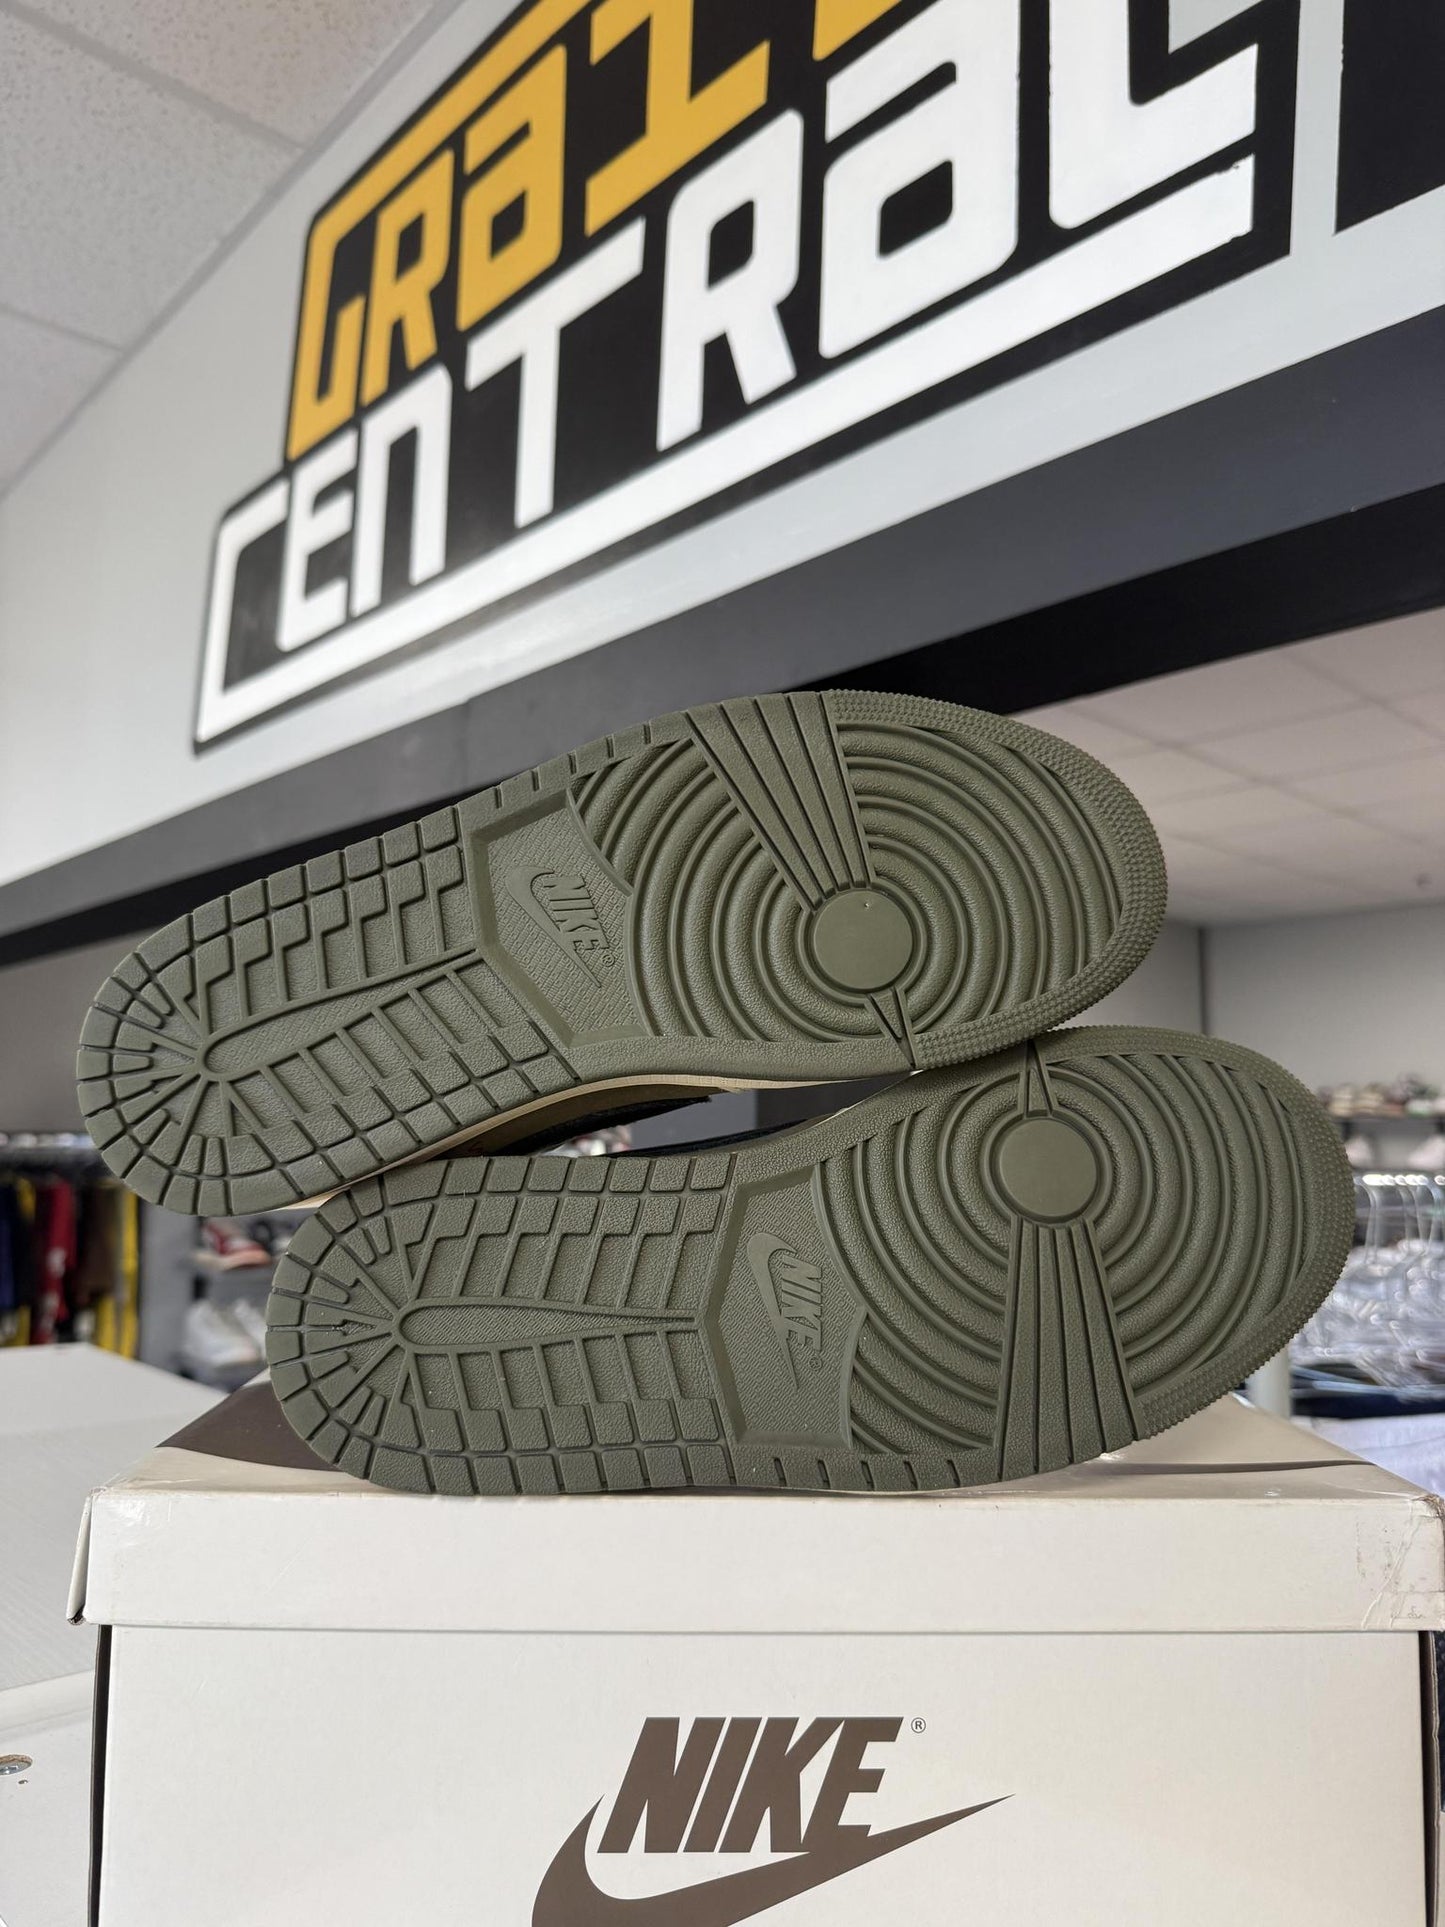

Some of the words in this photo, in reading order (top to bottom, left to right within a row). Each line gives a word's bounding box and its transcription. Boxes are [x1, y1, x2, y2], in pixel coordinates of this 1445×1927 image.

[543, 873, 610, 951] NIKE
[781, 1253, 822, 1351] NIKE
[597, 1716, 904, 1853] NIKE
